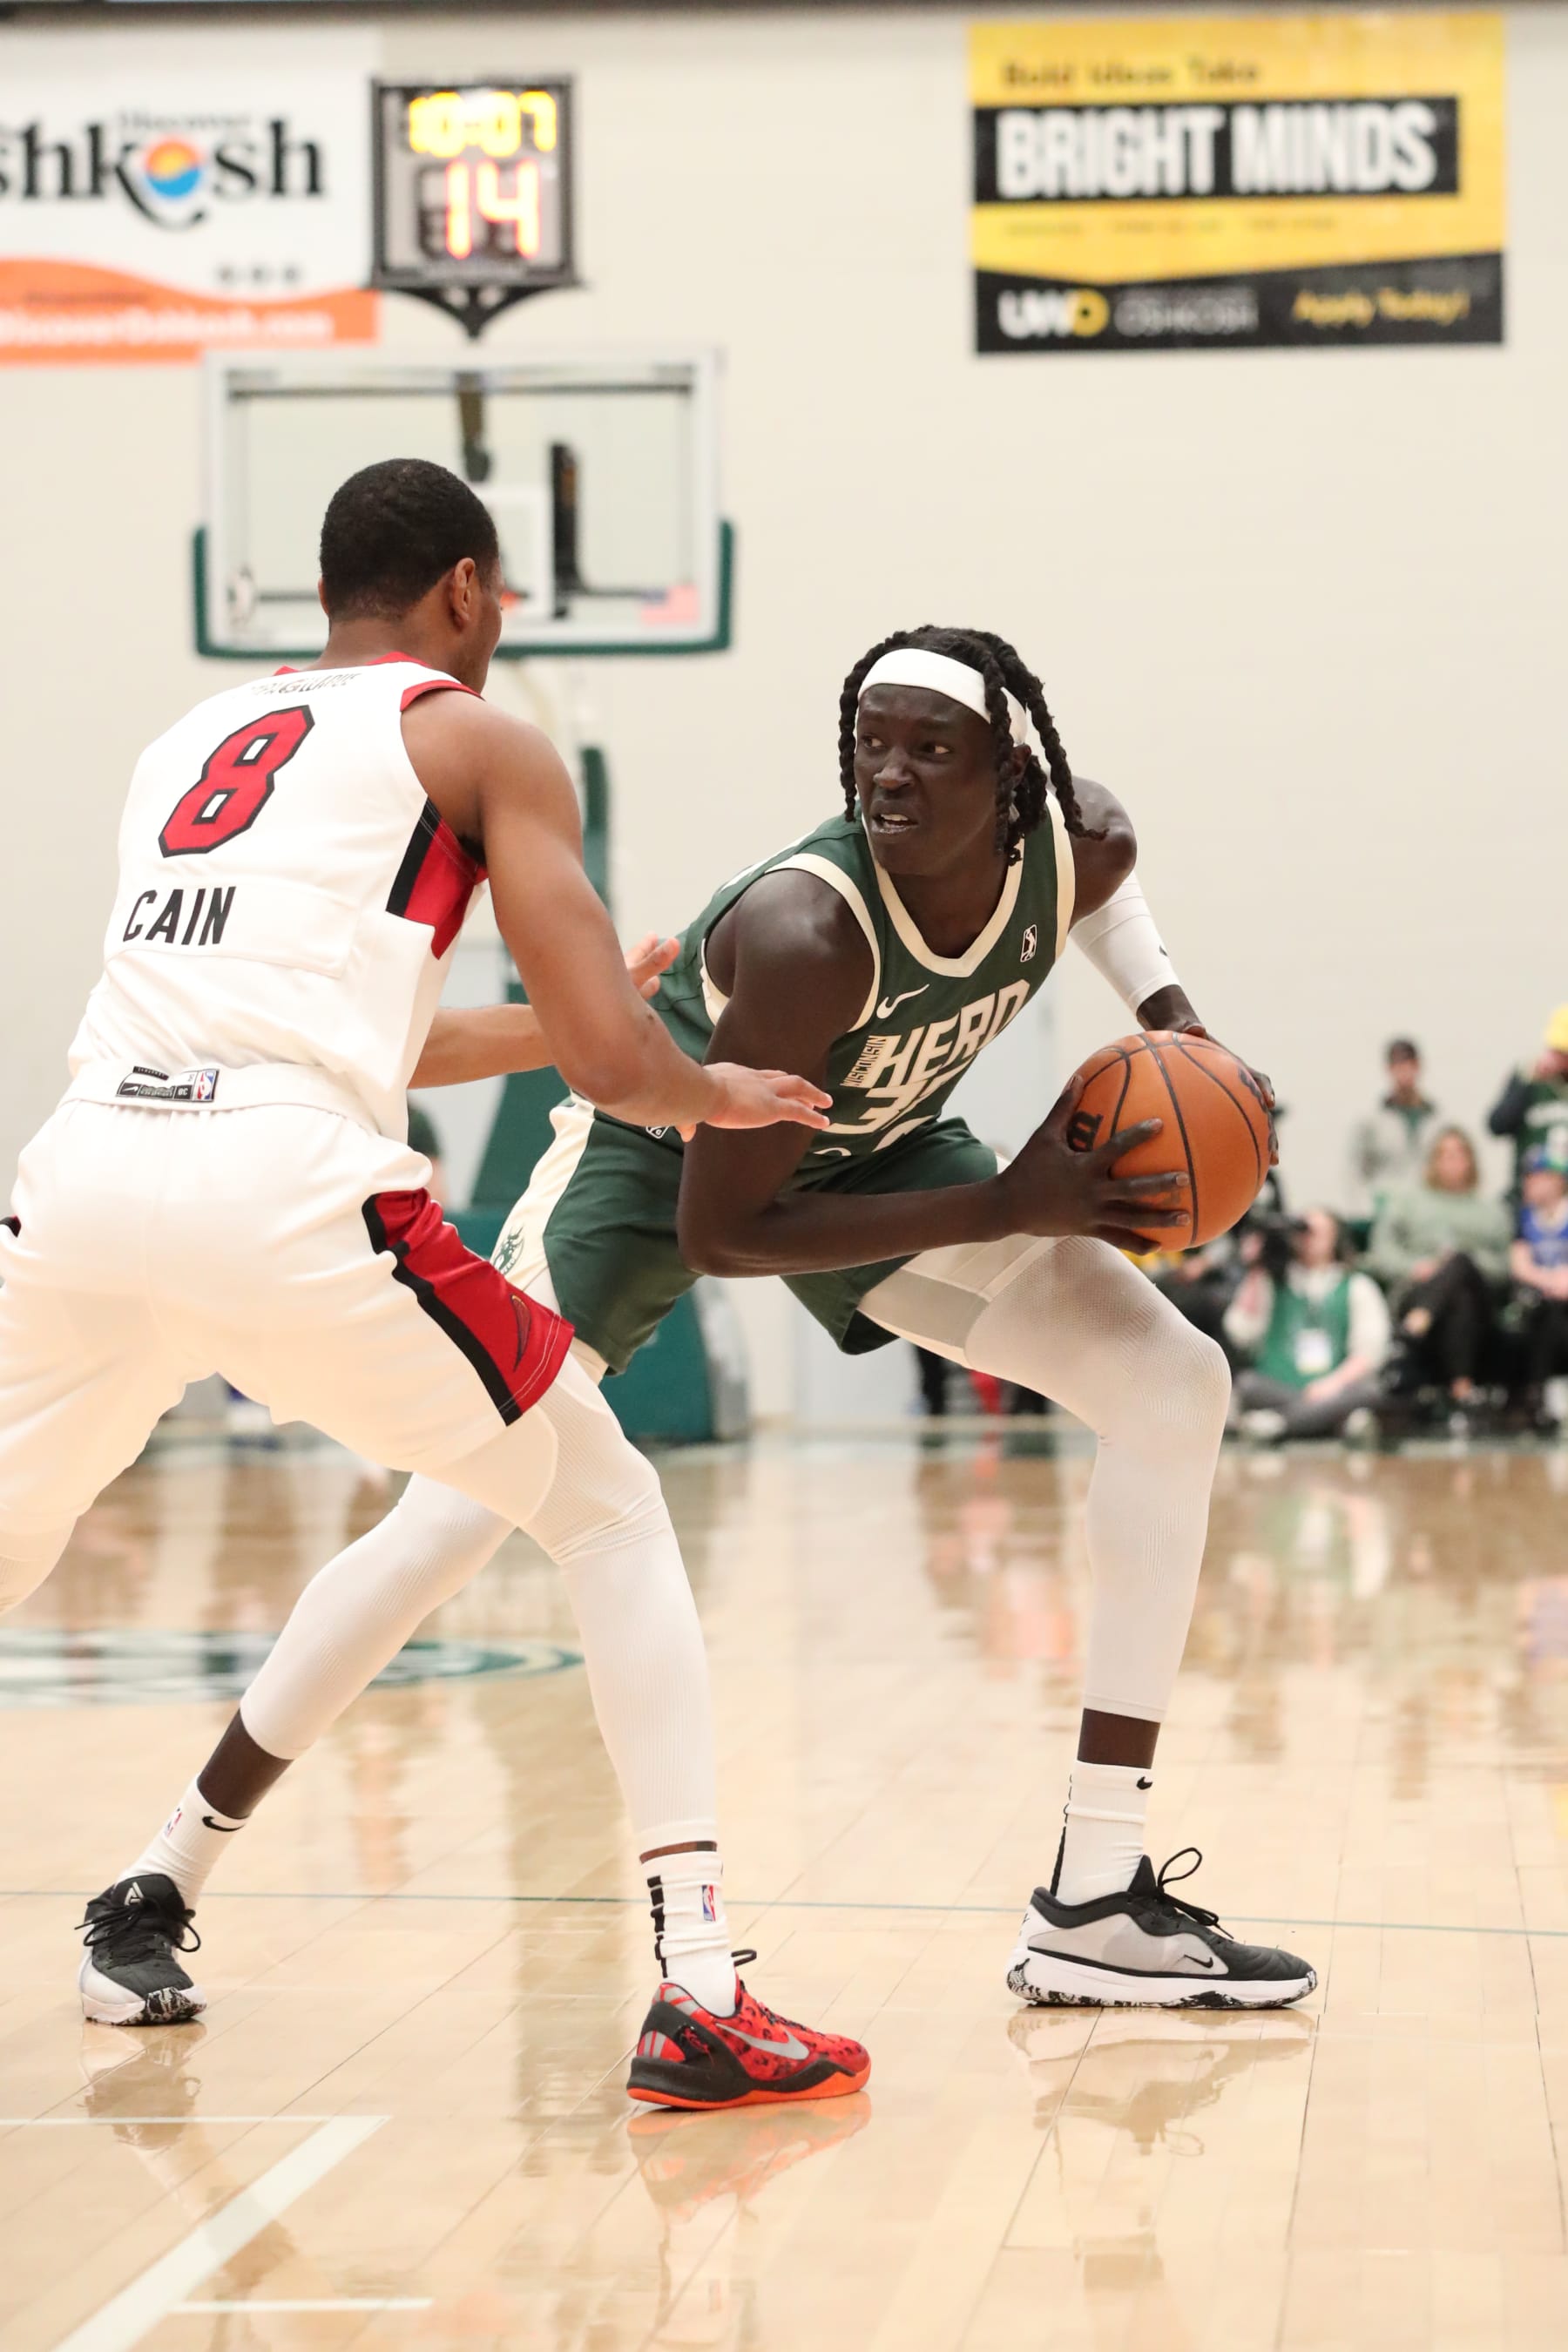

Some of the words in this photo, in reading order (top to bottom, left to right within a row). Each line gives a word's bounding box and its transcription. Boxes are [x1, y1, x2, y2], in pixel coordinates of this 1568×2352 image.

[997, 105, 1225, 199] BRIGHT
[1231, 101, 1437, 193] MINDS
[444, 158, 542, 260] 14
[158, 705, 315, 858] 8
[123, 886, 237, 946] CAIN
[870, 978, 1031, 1089] HERD
